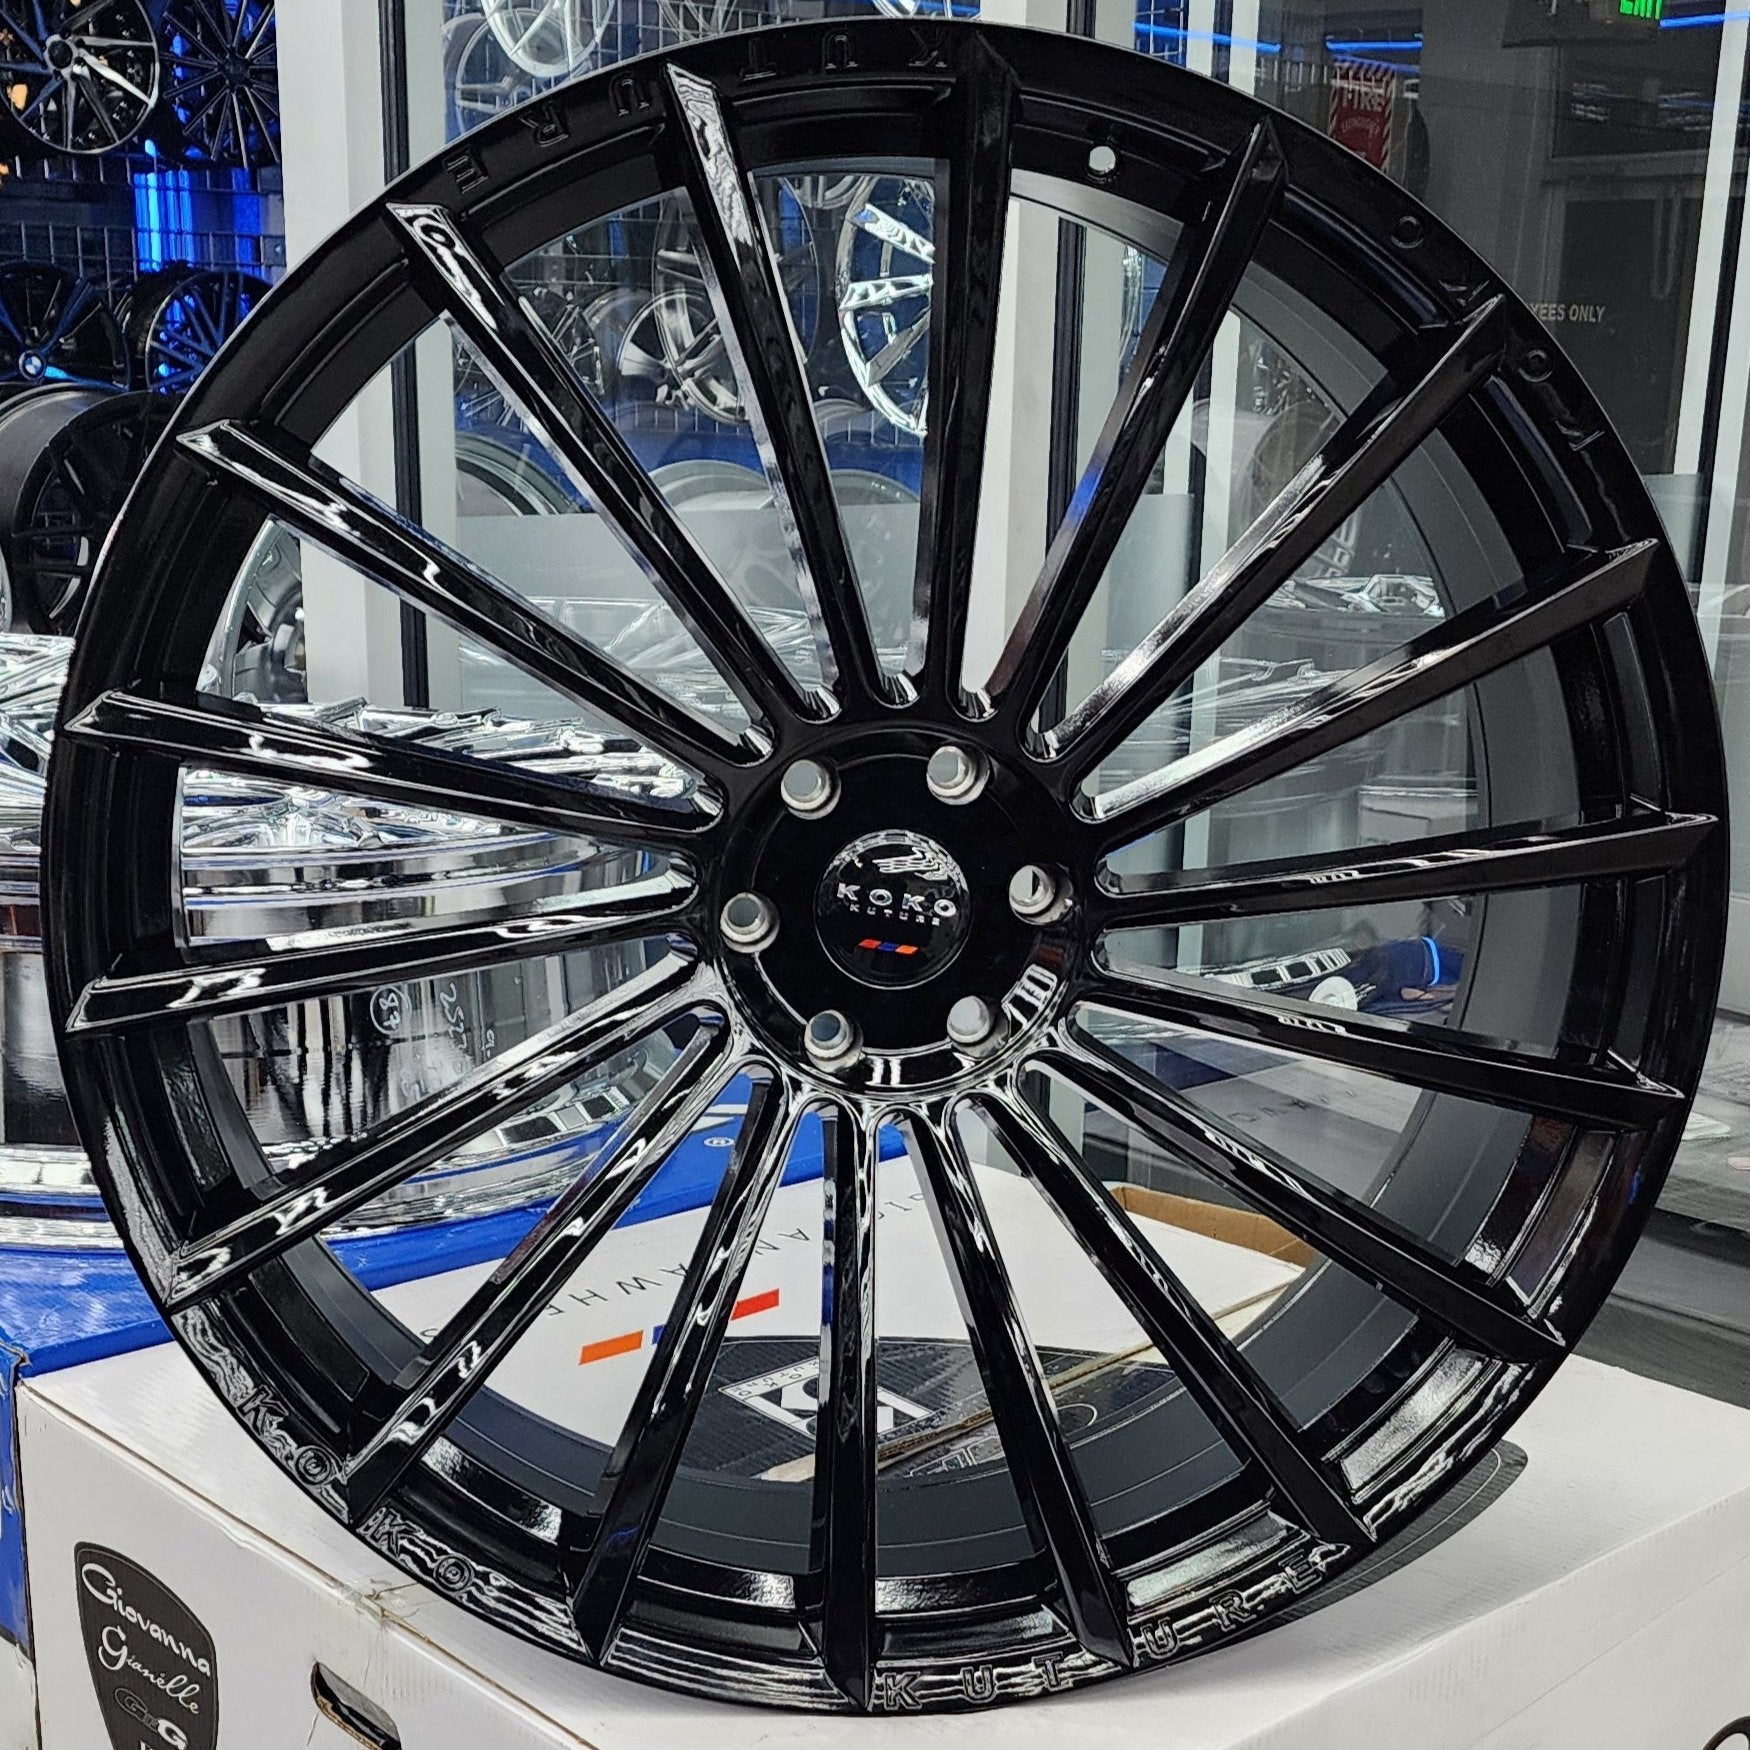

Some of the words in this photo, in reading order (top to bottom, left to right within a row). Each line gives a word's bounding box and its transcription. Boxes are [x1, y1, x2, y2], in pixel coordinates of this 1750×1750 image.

[1569, 304, 1606, 322] ONLY
[836, 882, 957, 917] KOKO
[850, 903, 940, 926] KUTURE
[82, 1563, 210, 1677] Giovanna
